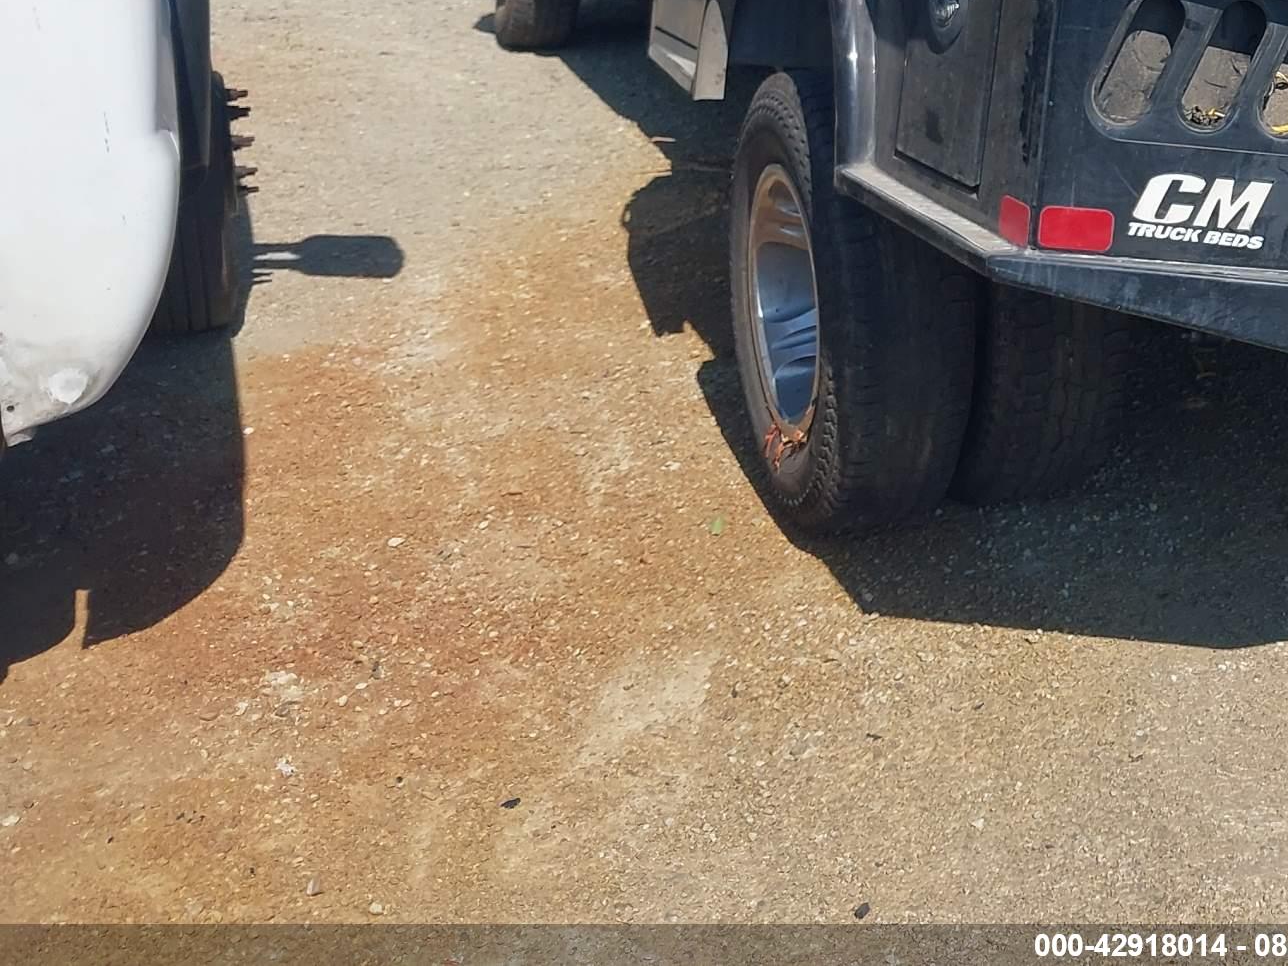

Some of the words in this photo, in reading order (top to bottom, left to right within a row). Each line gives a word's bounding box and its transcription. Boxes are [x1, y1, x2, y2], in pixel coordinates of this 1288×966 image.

[1131, 173, 1274, 231] CM
[1127, 222, 1202, 242] TRUCK
[1203, 230, 1265, 250] BEDS
